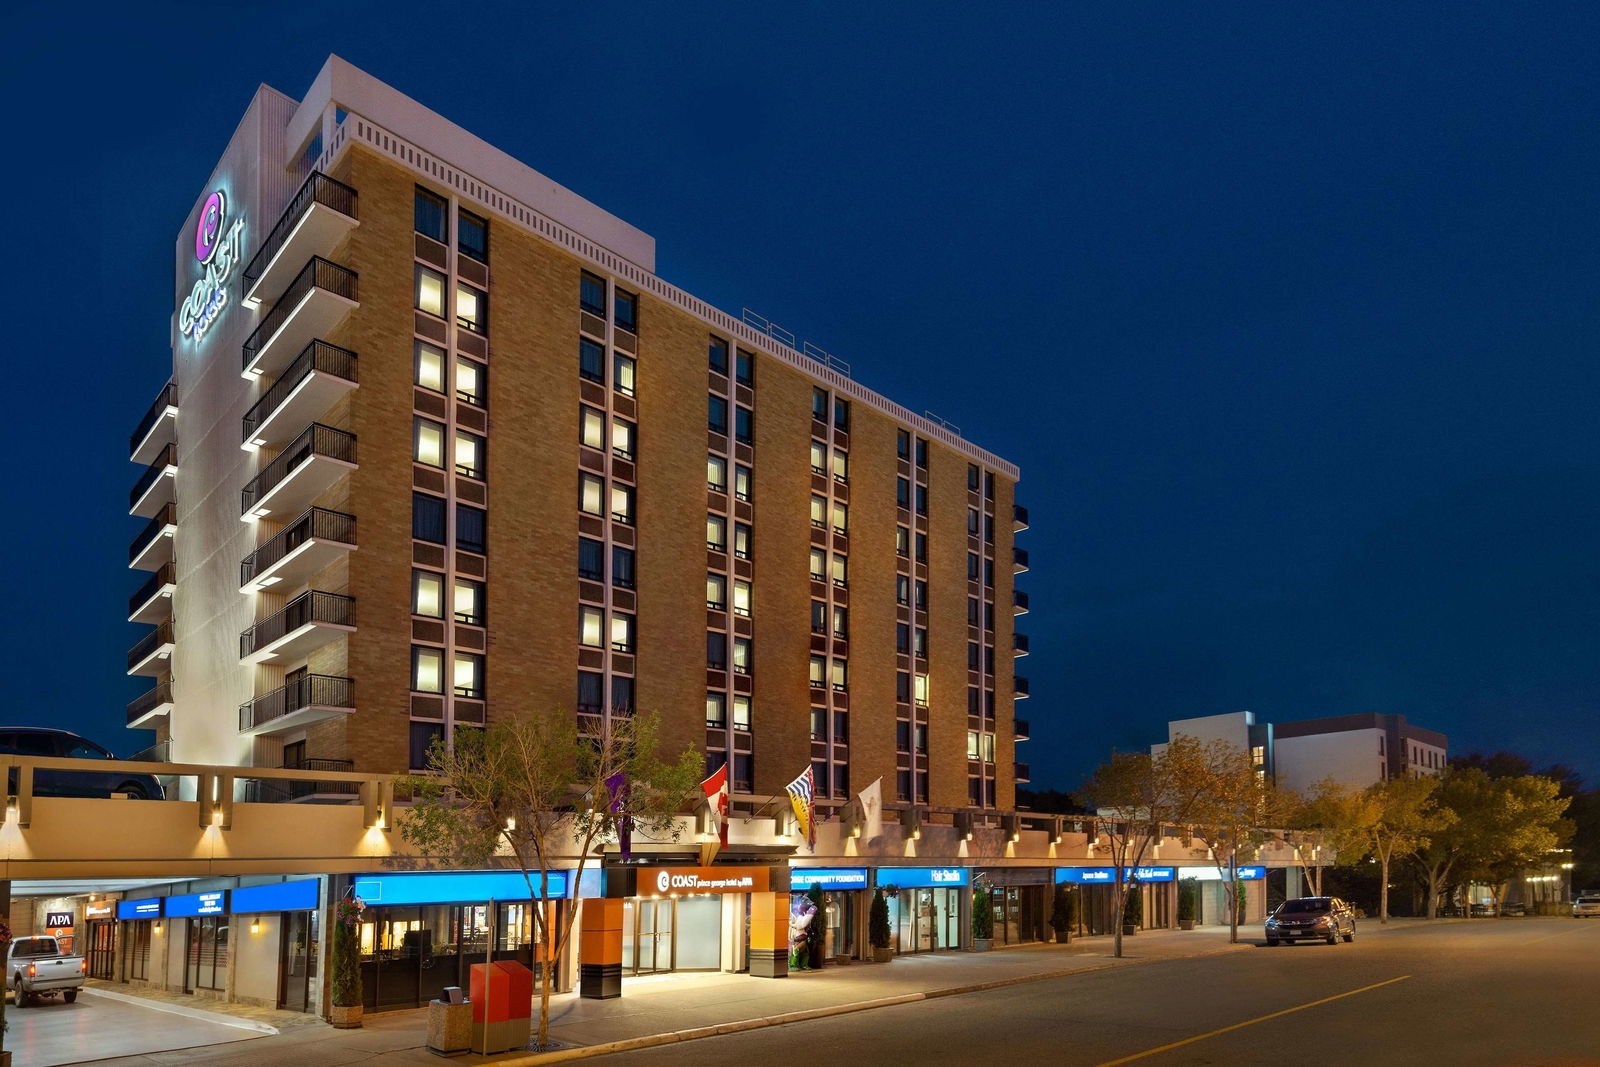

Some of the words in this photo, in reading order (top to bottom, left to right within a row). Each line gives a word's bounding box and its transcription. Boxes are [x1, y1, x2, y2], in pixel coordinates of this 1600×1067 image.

[179, 218, 245, 335] COAST
[672, 875, 698, 888] COAST
[805, 875, 836, 883] COMMUNITY
[836, 874, 864, 882] FOUNDATION
[49, 915, 71, 926] APA
